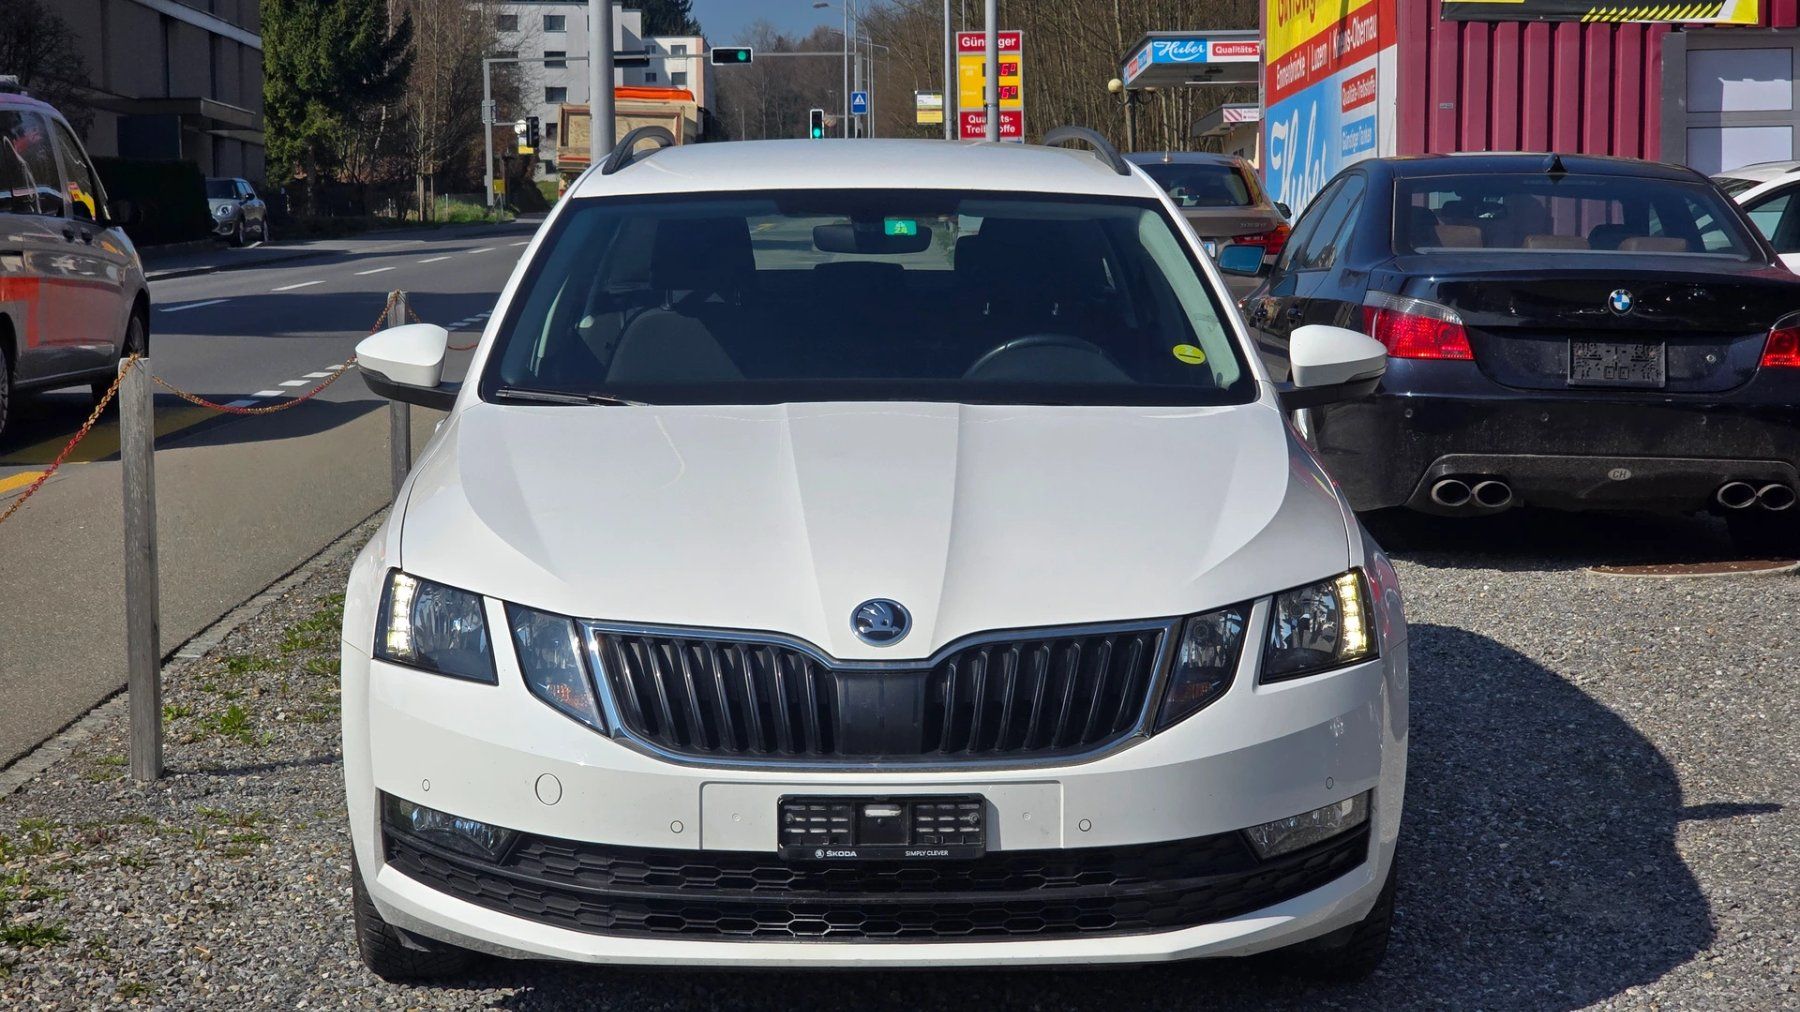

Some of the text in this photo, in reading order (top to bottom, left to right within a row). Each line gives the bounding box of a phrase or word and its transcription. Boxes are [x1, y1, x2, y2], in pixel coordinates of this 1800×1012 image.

[961, 36, 1016, 48] Günger
[1153, 41, 1206, 61] Huber
[1311, 43, 1328, 72] Luzern
[967, 114, 1013, 124] Quats-
[966, 125, 1016, 134] Treioffe
[826, 849, 857, 857] ŠKODA
